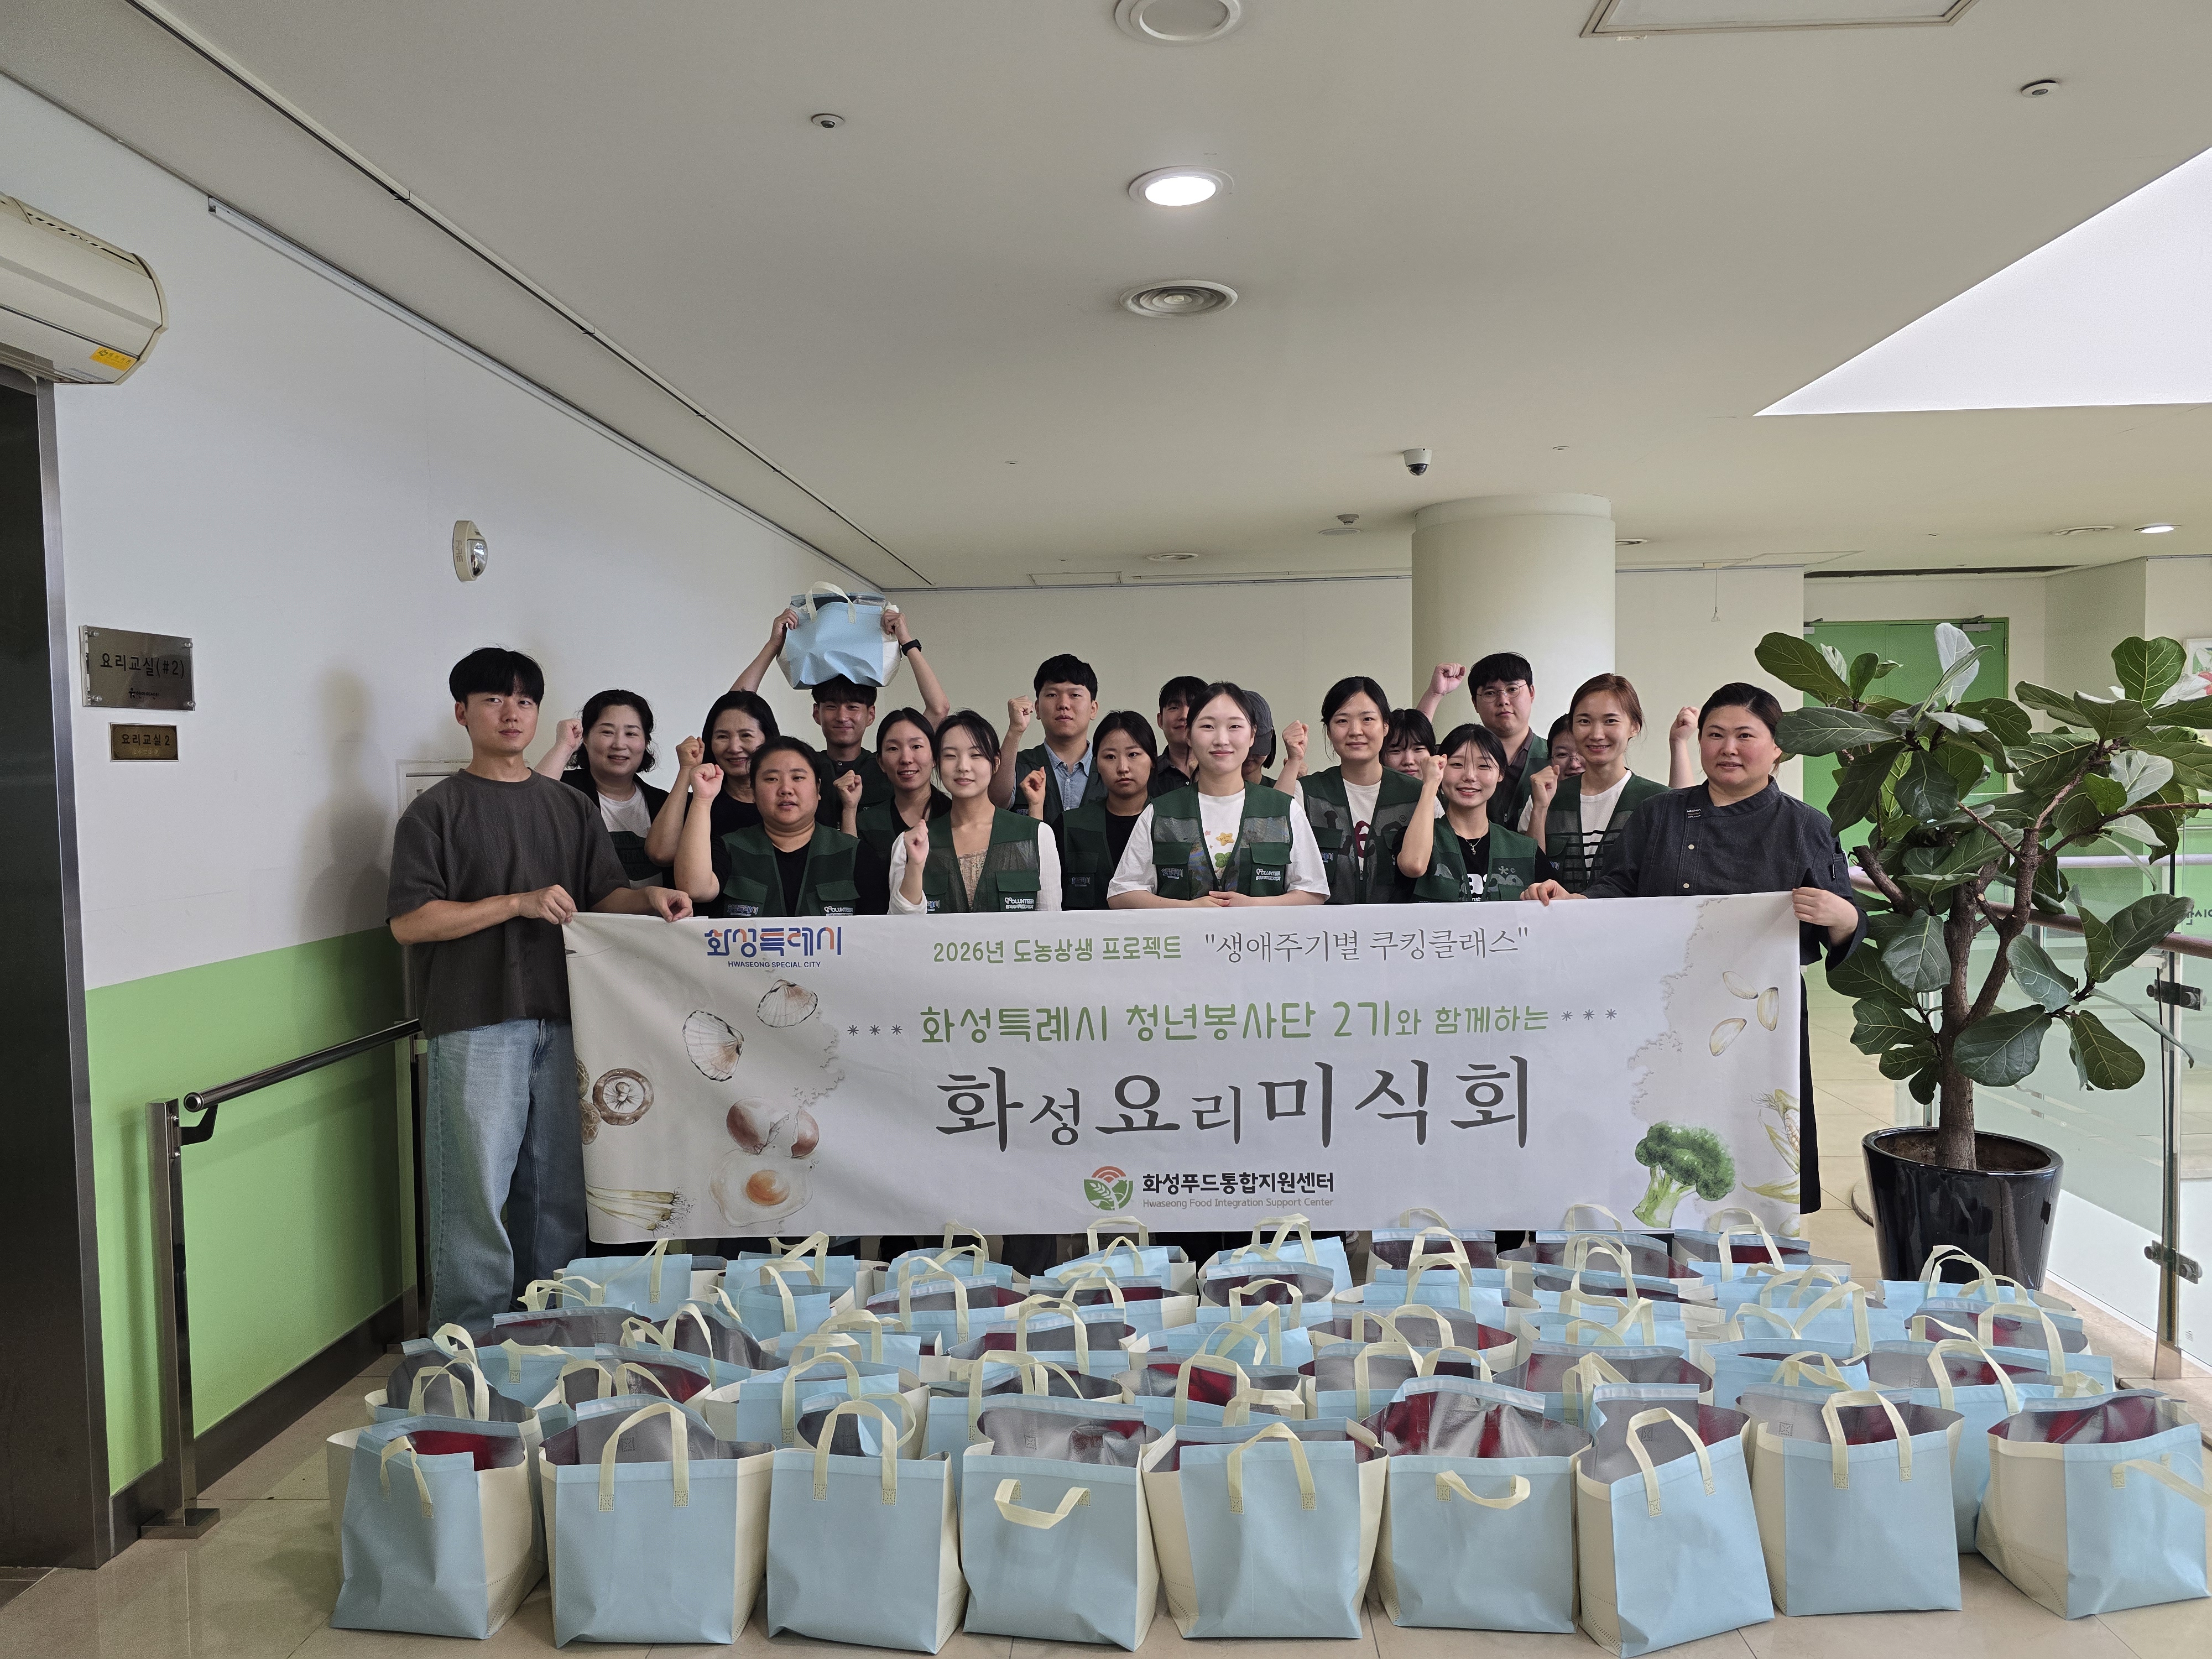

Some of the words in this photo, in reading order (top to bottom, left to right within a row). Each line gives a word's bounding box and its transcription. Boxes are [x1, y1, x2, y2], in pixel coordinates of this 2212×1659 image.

[100, 653, 184, 680] 요리교실(#2)
[122, 733, 161, 746] 요리교실
[165, 735, 170, 746] 2
[704, 926, 842, 958] 화성특례시
[933, 940, 1004, 964] 2026년
[1014, 937, 1093, 962] 도농상생
[1102, 936, 1182, 960] 프로젝트
[1205, 930, 1360, 963] "생애주기별
[1369, 926, 1528, 962] 쿠킹클래스"
[920, 1005, 1107, 1044] 화성특례시
[1126, 1001, 1317, 1042] 청년봉사단
[1333, 1000, 1422, 1037] 2기와
[1434, 1005, 1549, 1034] 함께하는
[1142, 1172, 1334, 1194] 화성푸드통합지원센터
[1143, 1198, 1187, 1209] Hwaseong
[1190, 1198, 1212, 1208] Food
[1214, 1198, 1264, 1209] Integration
[1265, 1197, 1302, 1209] Support
[1304, 1197, 1334, 1207] Center
